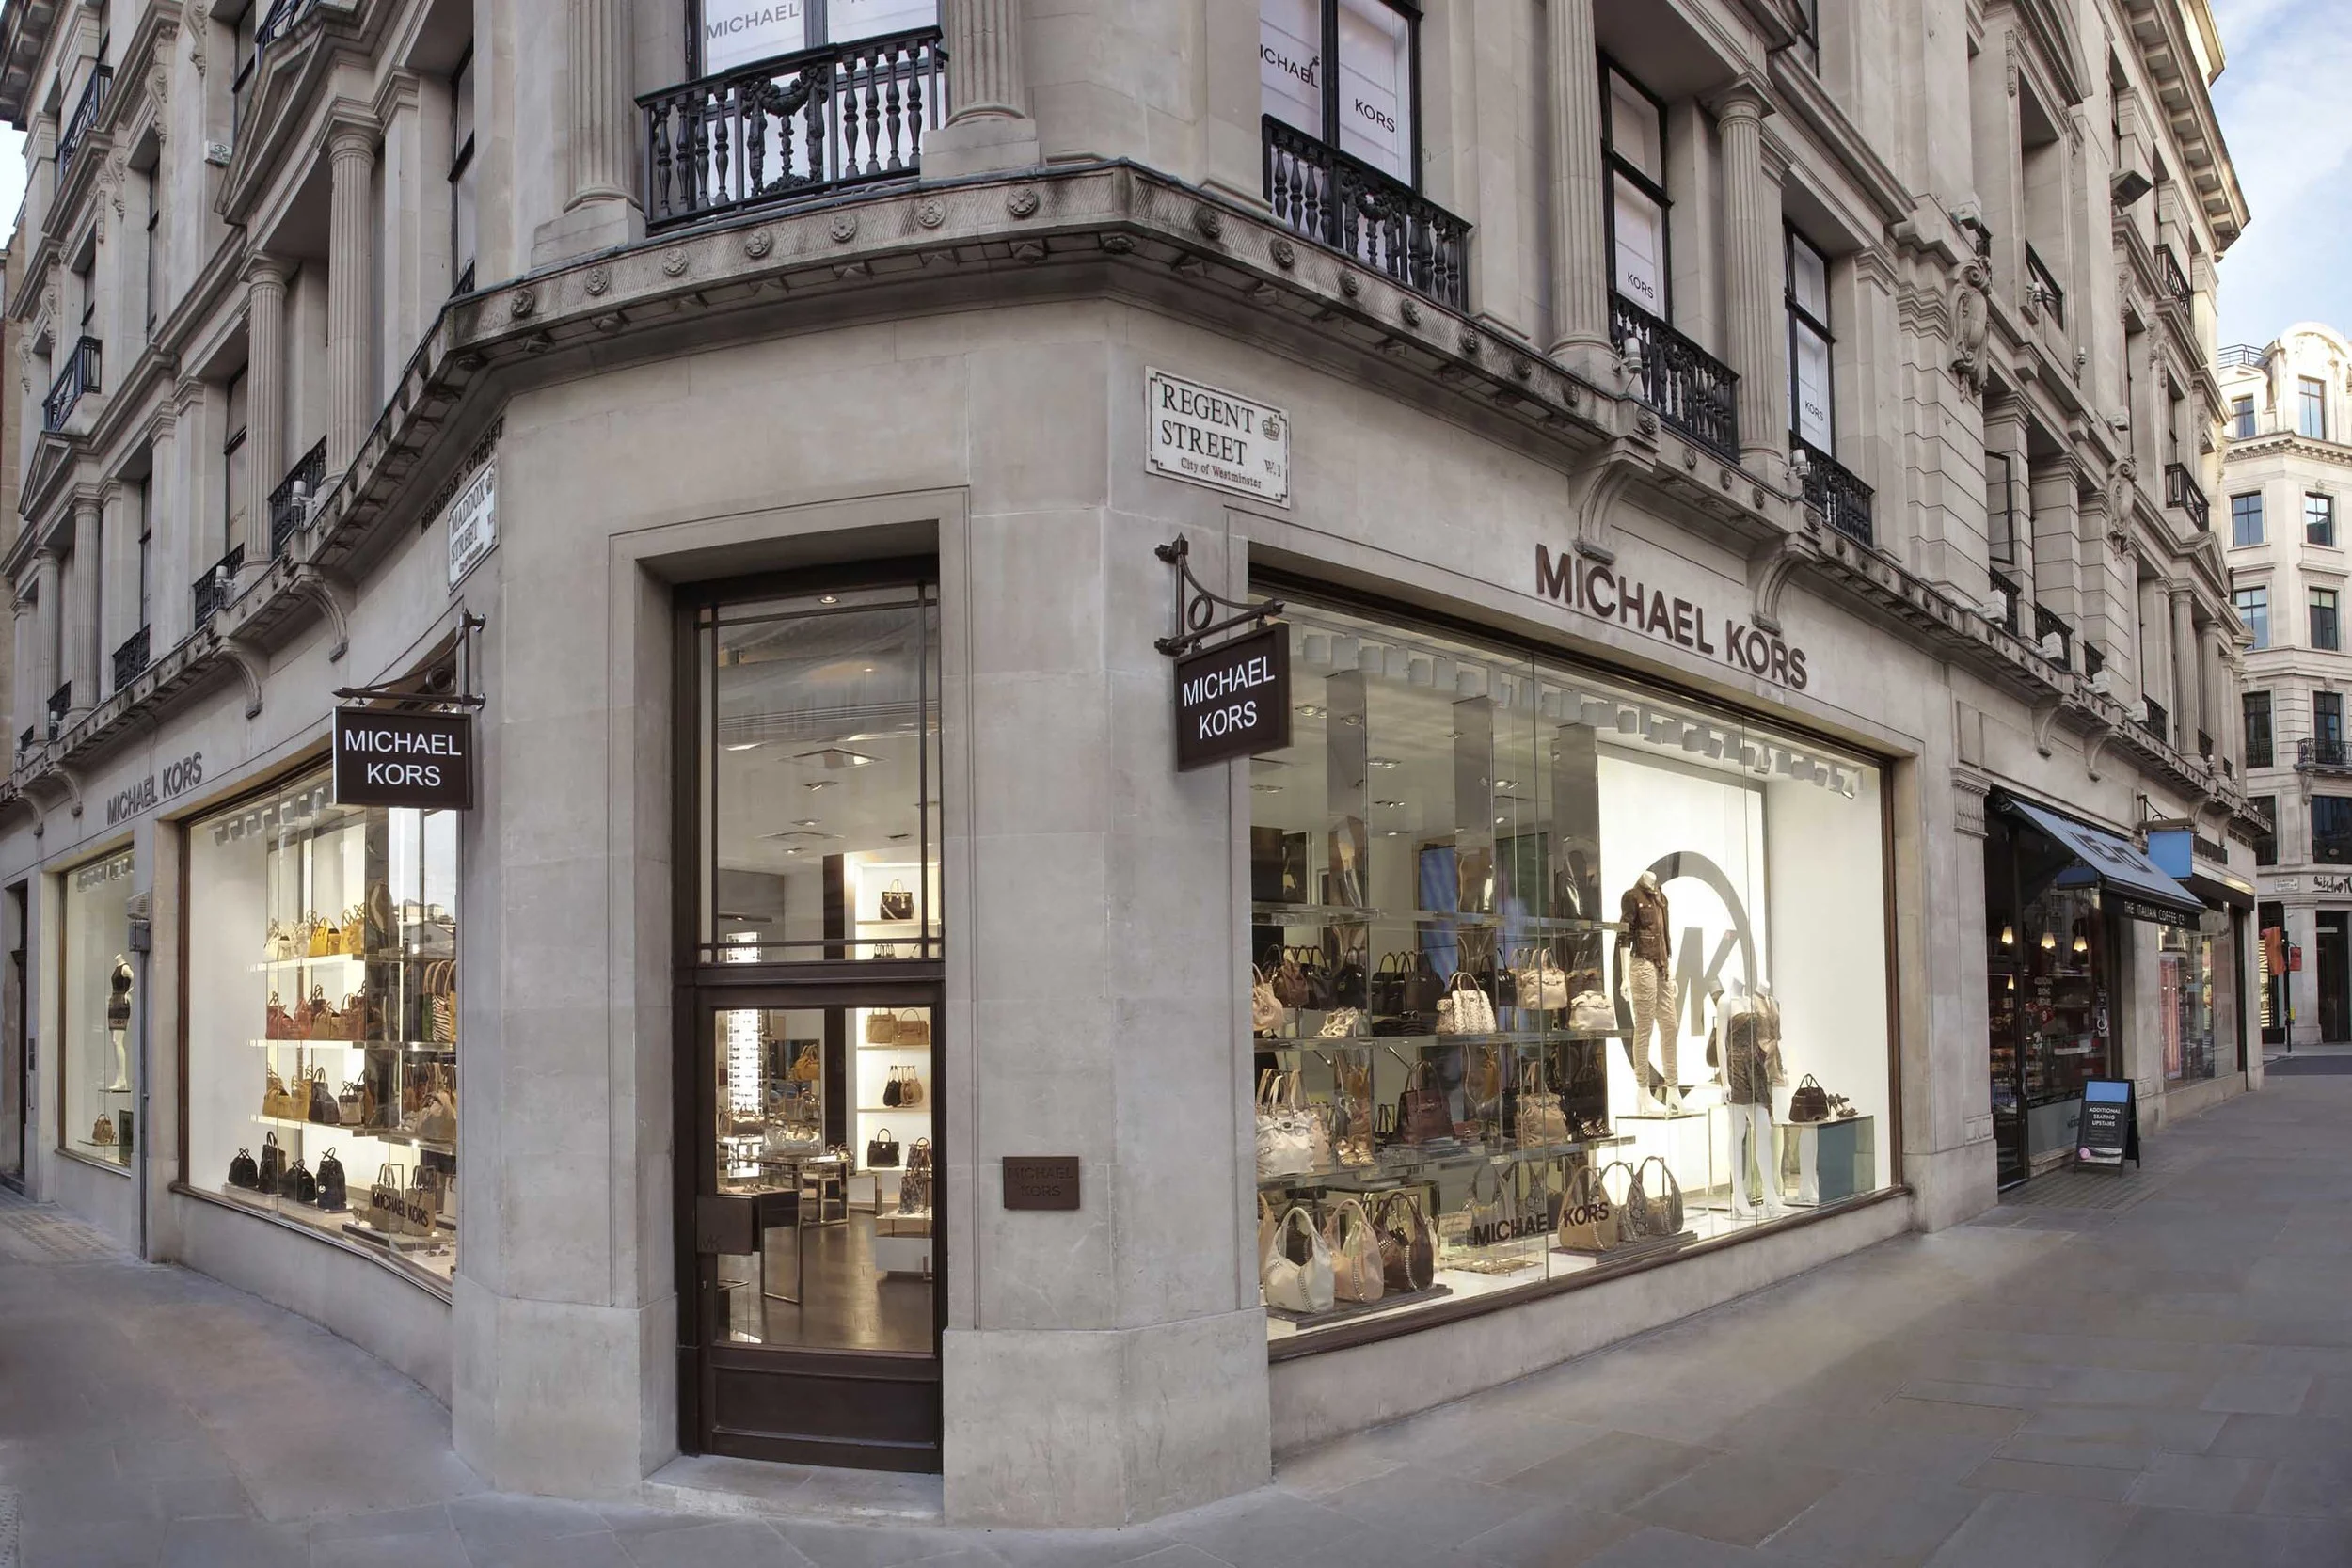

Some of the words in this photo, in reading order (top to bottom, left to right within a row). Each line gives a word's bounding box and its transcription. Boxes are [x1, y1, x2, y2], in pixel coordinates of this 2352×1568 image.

[706, 3, 799, 40] MICHAEL
[1355, 98, 1395, 133] KORS
[1628, 272, 1653, 299] KORS
[1161, 382, 1254, 434] REGENT
[1804, 400, 1823, 421] KORS
[1161, 420, 1247, 466] STREET
[1181, 457, 1199, 475] City
[1200, 463, 1210, 475] of
[1212, 465, 1262, 489] Westminster
[1535, 543, 1714, 655] MICHAEL
[1726, 619, 1807, 689] KORS
[1184, 656, 1276, 707] MICHAEL
[1200, 700, 1258, 740] KORS
[345, 729, 462, 755] MICHAEL
[107, 774, 158, 825] MICHAEL
[163, 751, 202, 799] KORS
[367, 763, 441, 786] KORS
[2158, 909, 2177, 924] COFFEE
[1021, 1185, 1061, 1196] KORS
[373, 1191, 406, 1218] MICHAEL
[408, 1203, 429, 1227] KORS
[1563, 1202, 1610, 1227] KORS
